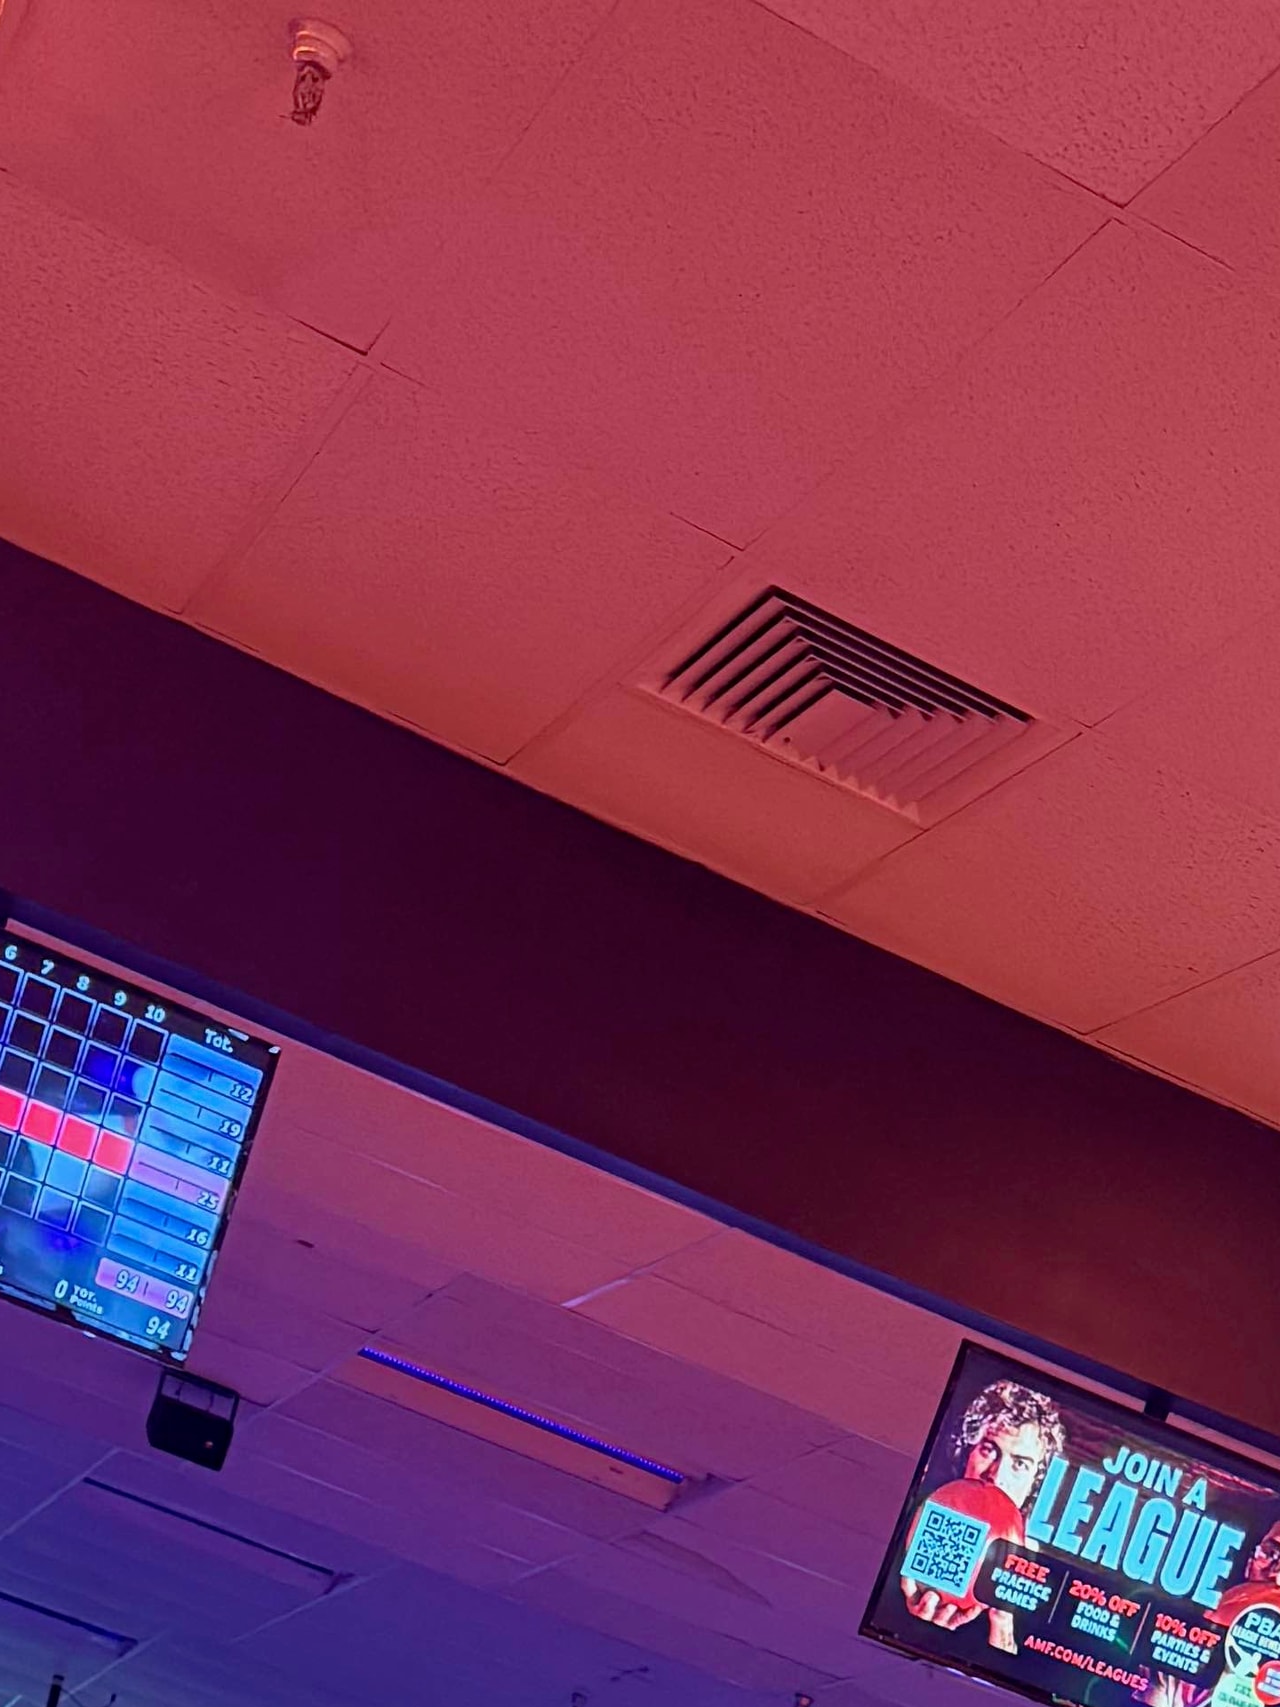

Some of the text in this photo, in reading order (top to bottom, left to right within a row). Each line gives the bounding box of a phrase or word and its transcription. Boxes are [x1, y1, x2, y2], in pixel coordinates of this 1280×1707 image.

[5, 946, 18, 961] 6
[41, 960, 55, 975] 7
[76, 976, 90, 991] 8
[114, 991, 127, 1006] 9
[145, 1004, 165, 1023] 10
[114, 1269, 139, 1294] 94
[164, 1289, 188, 1314] 94
[145, 1315, 170, 1340] 94
[1103, 1446, 1208, 1511] JOIN A
[1025, 1455, 1246, 1610] LEAGUE
[991, 1568, 1052, 1602] PRACTICE
[1004, 1553, 1050, 1584] FREE
[994, 1584, 1038, 1612] GAMES
[1069, 1579, 1141, 1618] 20% OFF
[1076, 1602, 1109, 1623] FOOD
[1071, 1614, 1117, 1642] DRINKS
[1150, 1630, 1200, 1660] PARTIES
[1154, 1613, 1186, 1638] 10%
[1189, 1626, 1221, 1649] OFF
[1024, 1634, 1151, 1692] AMF.COM/LEAGUES
[1152, 1646, 1200, 1674] EVENTS
